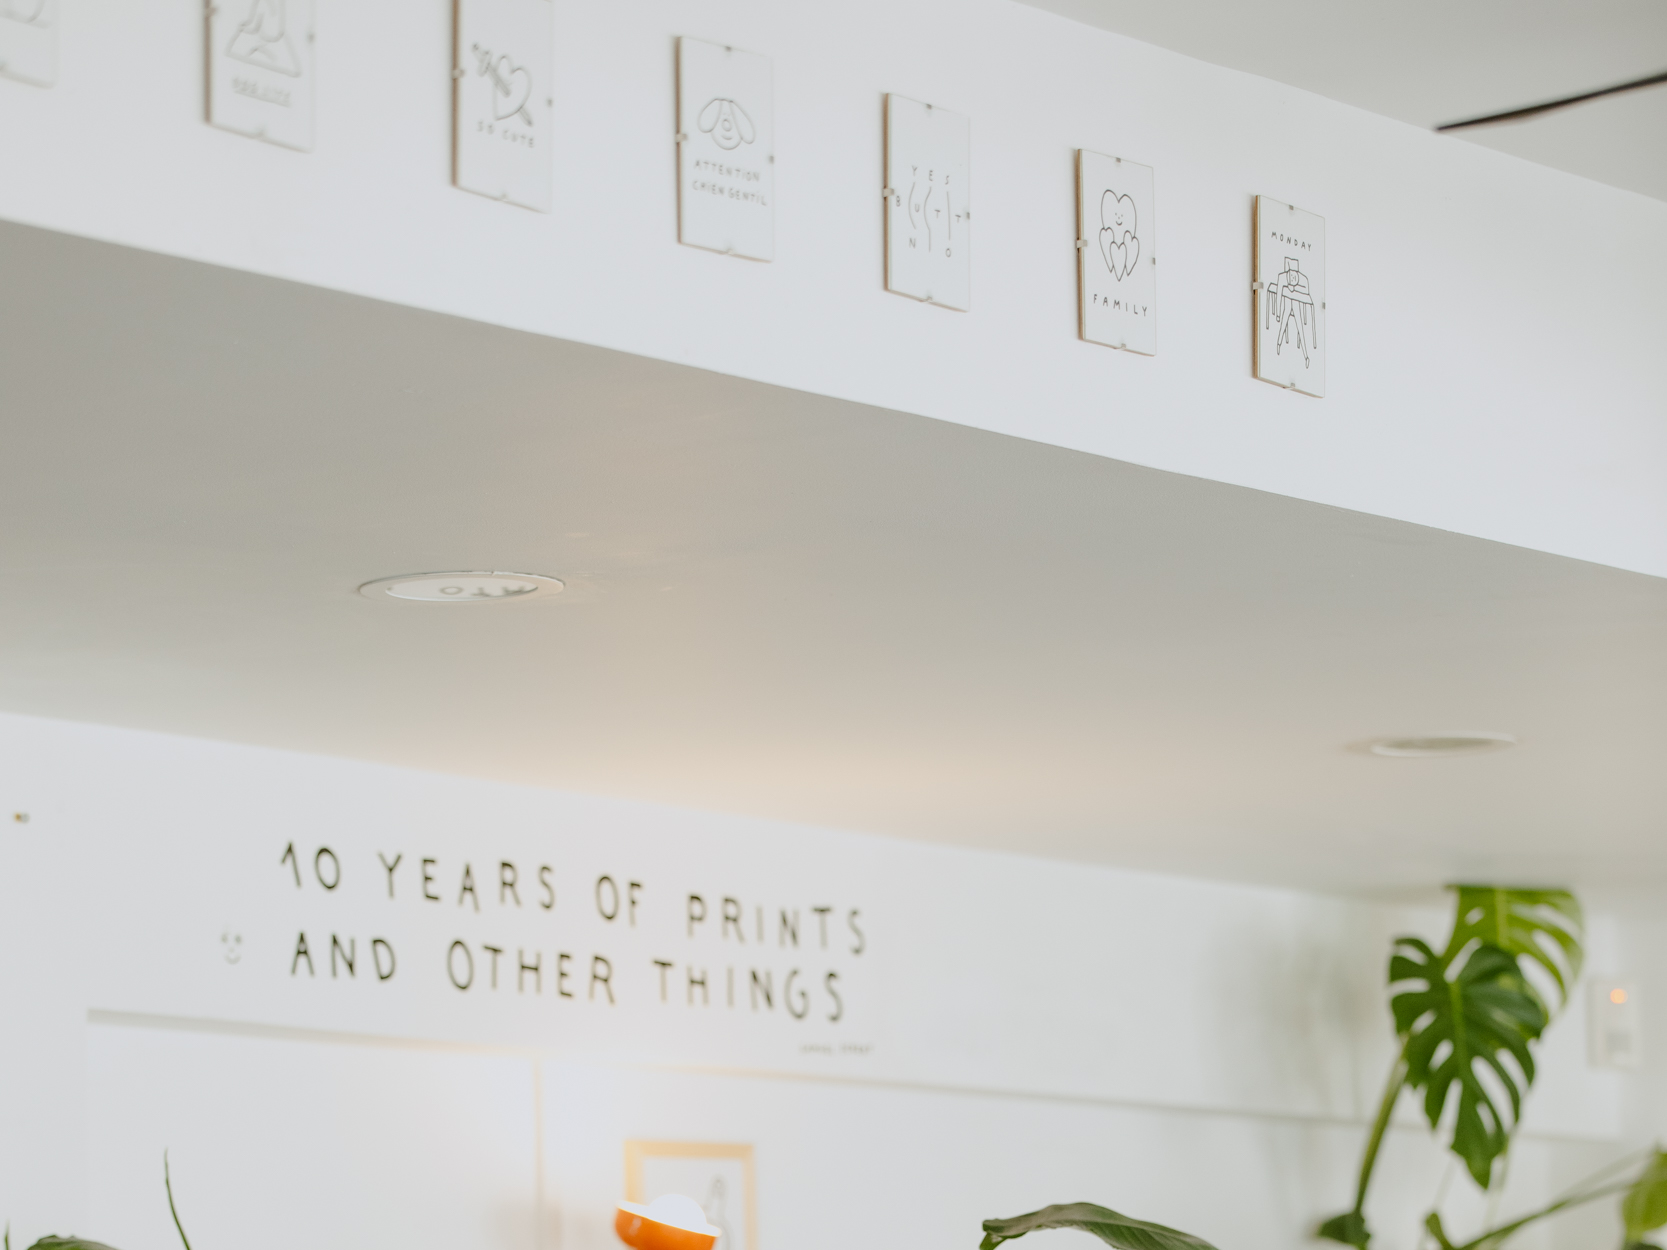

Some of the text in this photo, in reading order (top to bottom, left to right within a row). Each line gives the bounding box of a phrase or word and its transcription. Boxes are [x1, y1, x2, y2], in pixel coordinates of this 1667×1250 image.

[1271, 231, 1312, 252] MONDAY
[1093, 293, 1148, 317] FAMILY
[280, 841, 866, 955] 10 YEARS OF PRINTS
[290, 932, 844, 1023] AND OTHER THINGS
